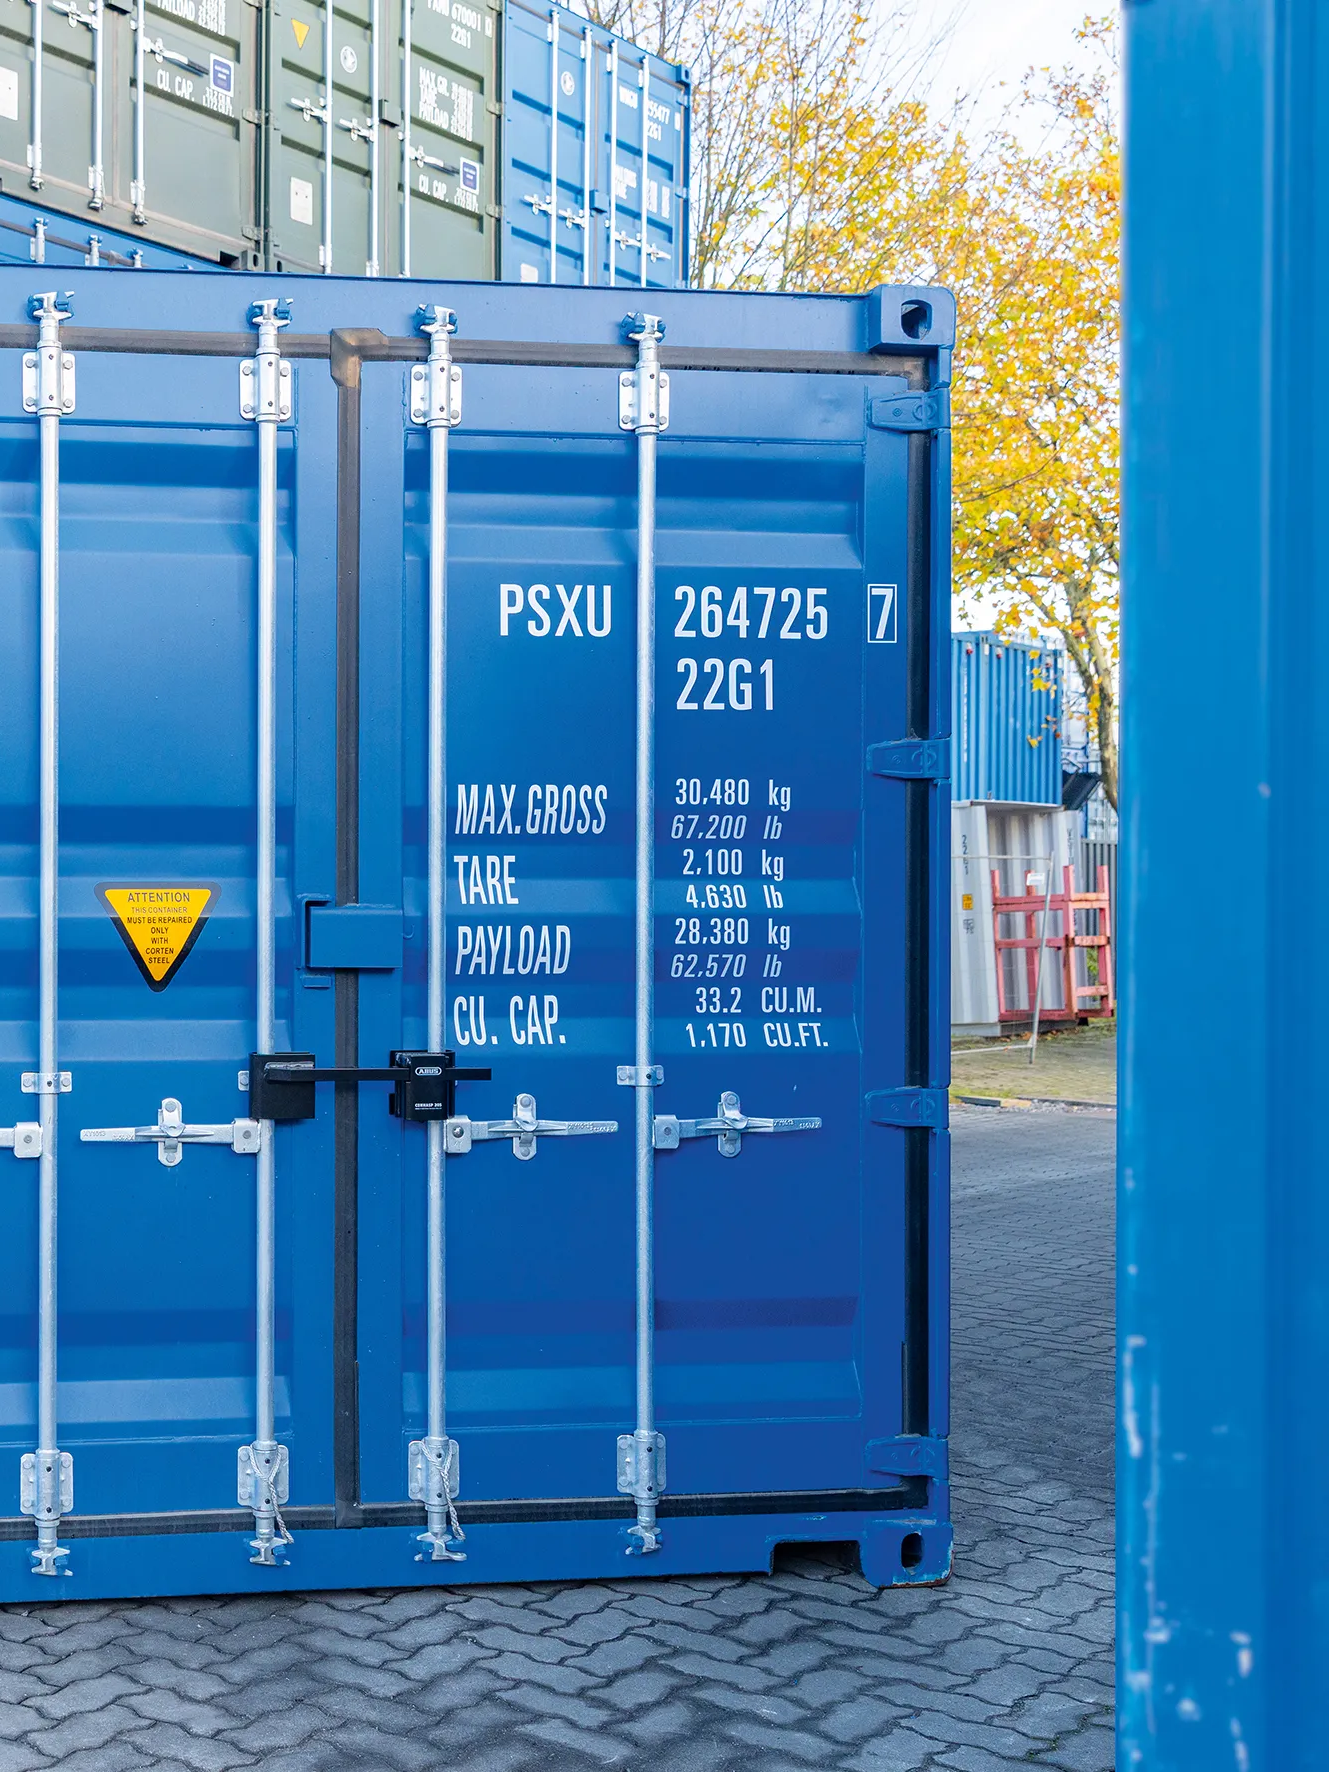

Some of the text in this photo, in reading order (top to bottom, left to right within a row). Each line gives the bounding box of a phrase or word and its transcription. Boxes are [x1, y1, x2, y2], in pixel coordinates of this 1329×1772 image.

[499, 583, 893, 640] PSXU 264725 7
[676, 658, 774, 711] 22G1
[454, 783, 608, 835] MAX.GROSS
[675, 779, 791, 811] 30,480 kg
[671, 815, 783, 840] 67,200 lb
[682, 849, 784, 881] 2,100 kg
[454, 855, 519, 905] TARE
[127, 892, 190, 903] ATTENTION
[685, 885, 784, 909] 4,630 lb
[127, 916, 193, 924] MUST BE REPAIRED
[150, 926, 169, 934] ONLY
[674, 918, 791, 951] 28,380 kg
[145, 947, 174, 955] CORTEN
[455, 925, 571, 975] PAYLOAD
[670, 954, 783, 978] 62,570 lb
[695, 986, 822, 1013] 33.2 CU.M.
[454, 995, 567, 1046] CU. CAP.
[685, 1022, 829, 1048] 1,170 CU.FT.
